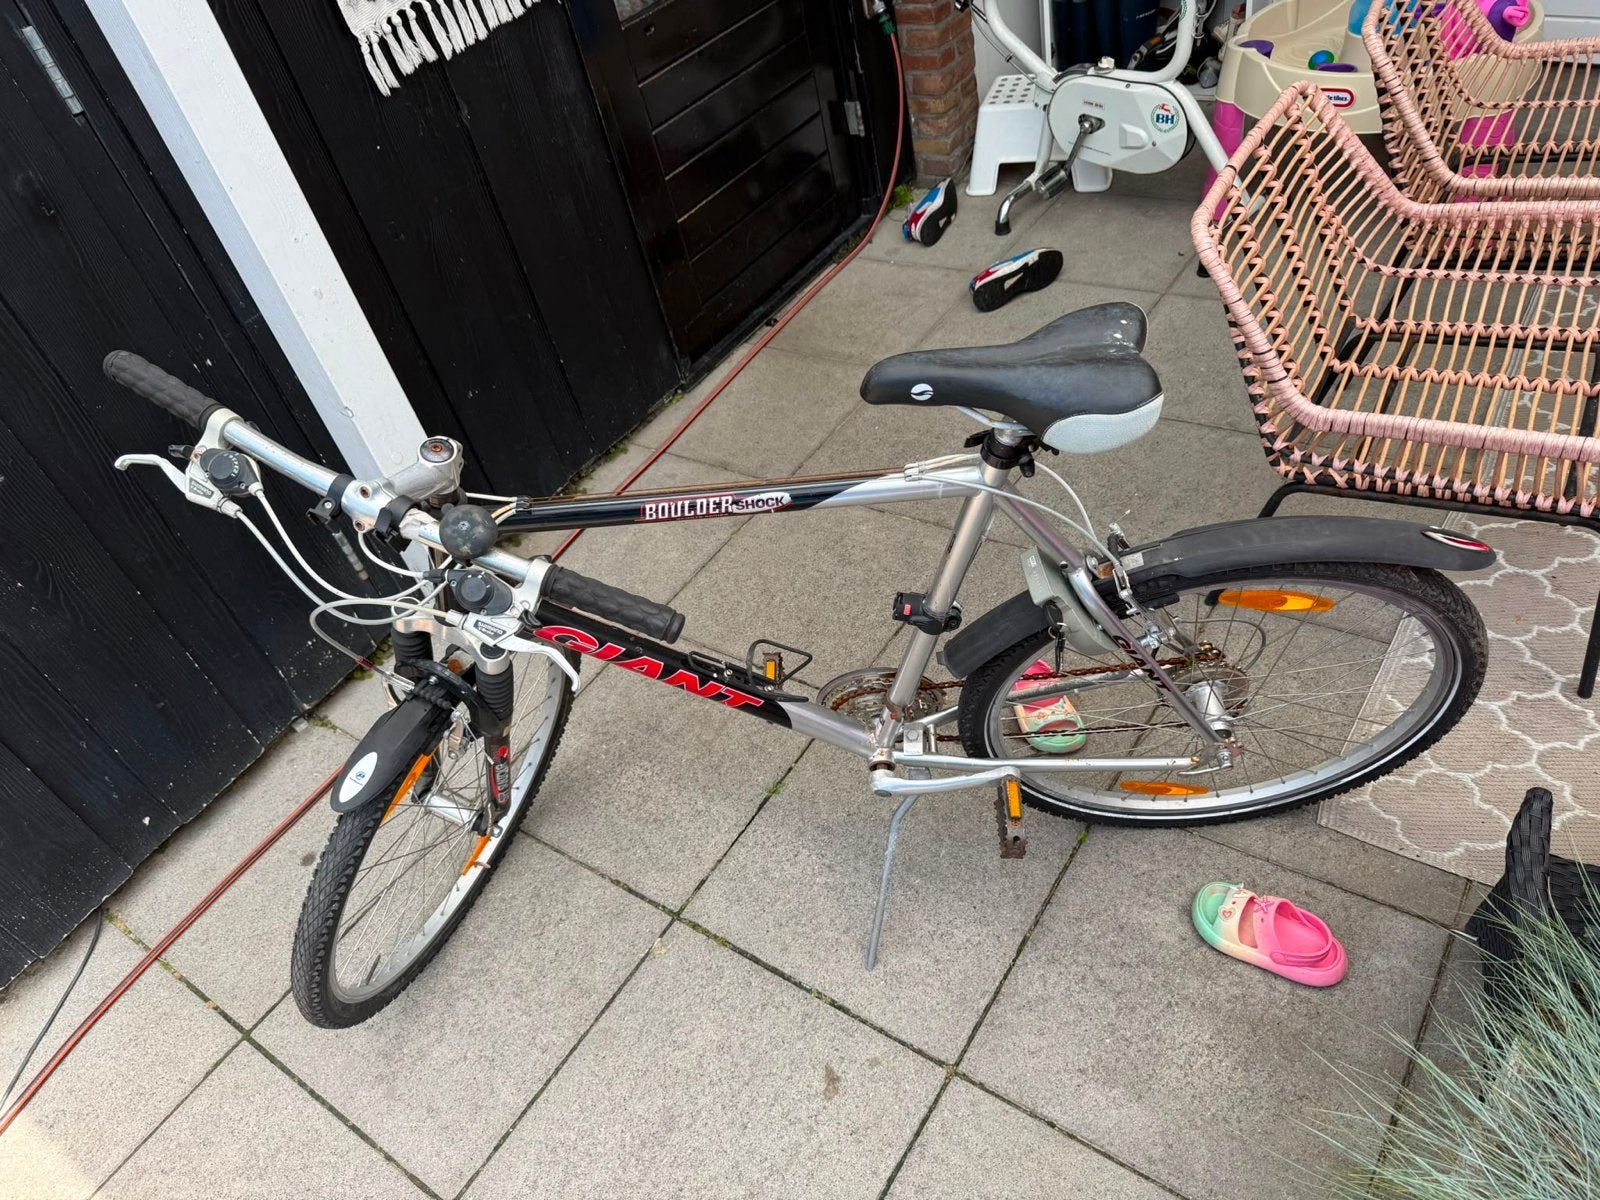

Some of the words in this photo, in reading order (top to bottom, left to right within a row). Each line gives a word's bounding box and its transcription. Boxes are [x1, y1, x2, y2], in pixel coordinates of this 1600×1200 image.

[1156, 113, 1175, 125] BH
[645, 495, 733, 520] BOULDER
[735, 496, 786, 511] SHOCK
[534, 626, 764, 707] GIANT
[1112, 635, 1172, 692] GIANT
